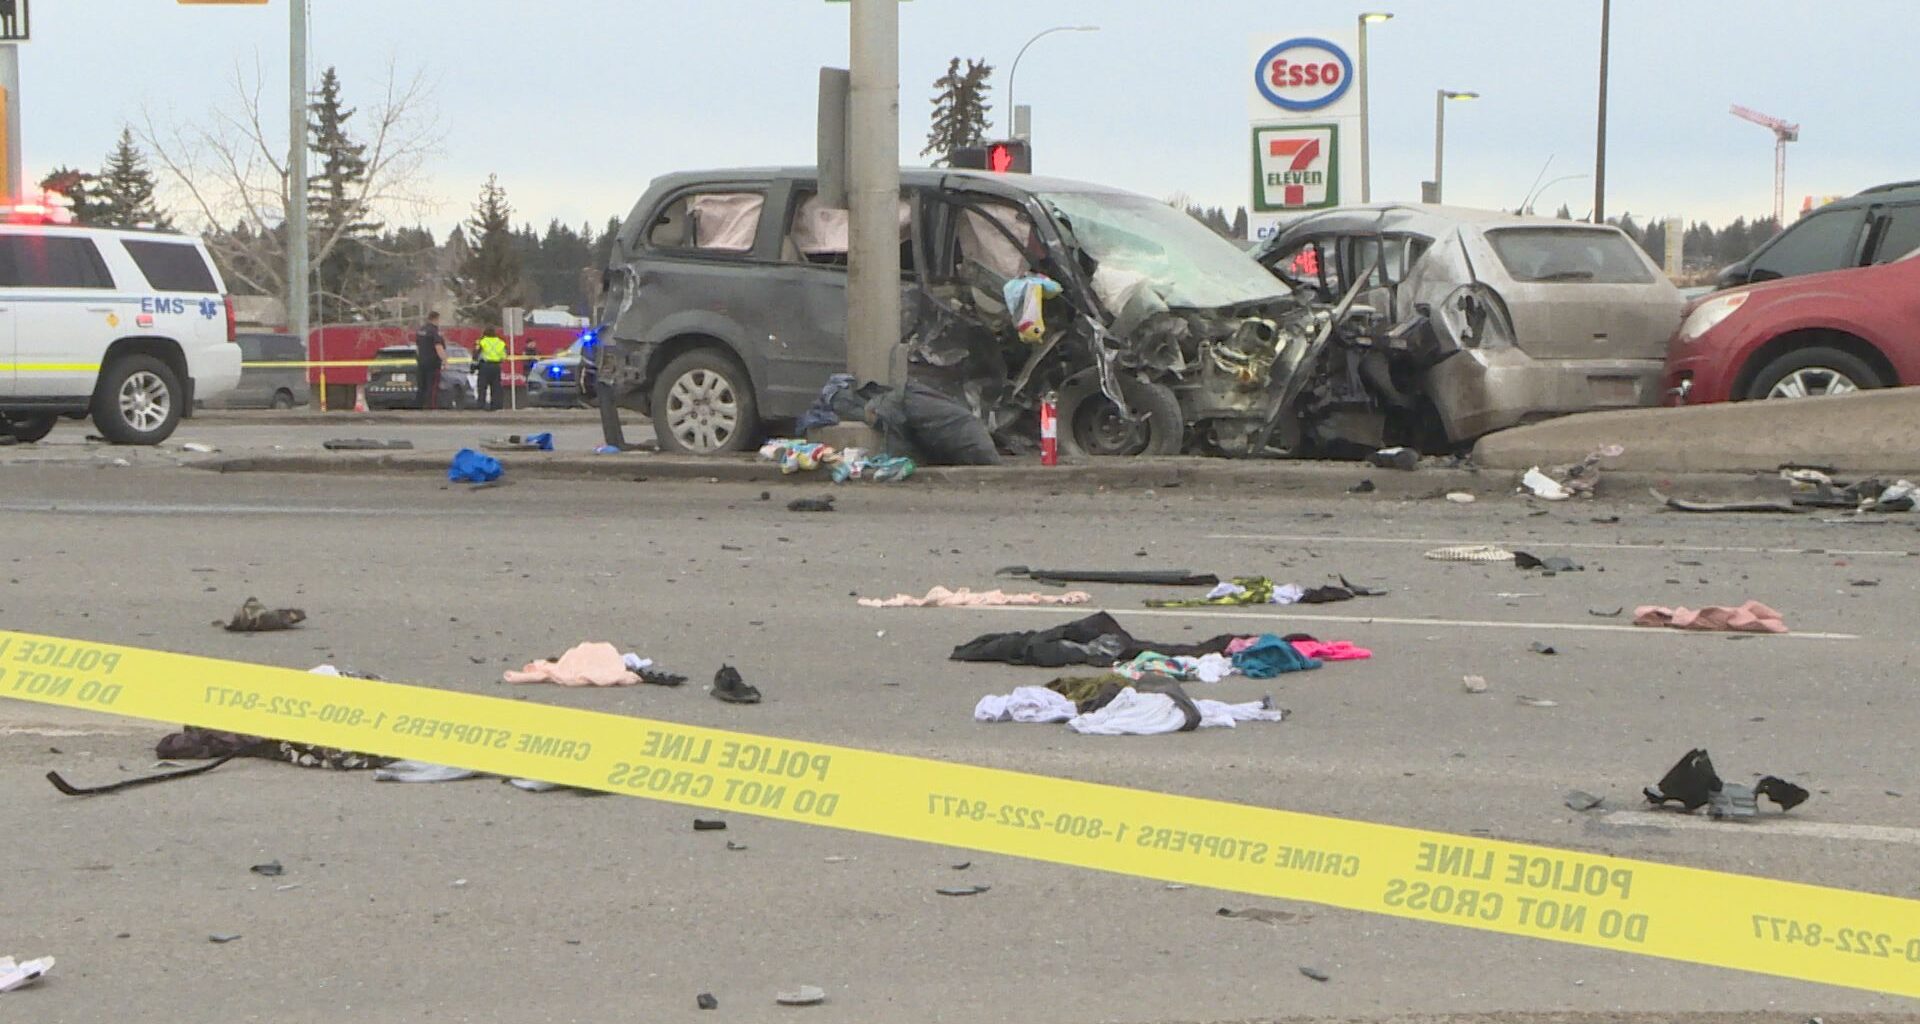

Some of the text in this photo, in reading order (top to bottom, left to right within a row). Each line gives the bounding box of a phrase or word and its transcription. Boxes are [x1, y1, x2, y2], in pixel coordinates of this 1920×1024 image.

[1271, 60, 1339, 87] Esso
[1270, 138, 1320, 205] 7
[141, 298, 185, 314] EMS
